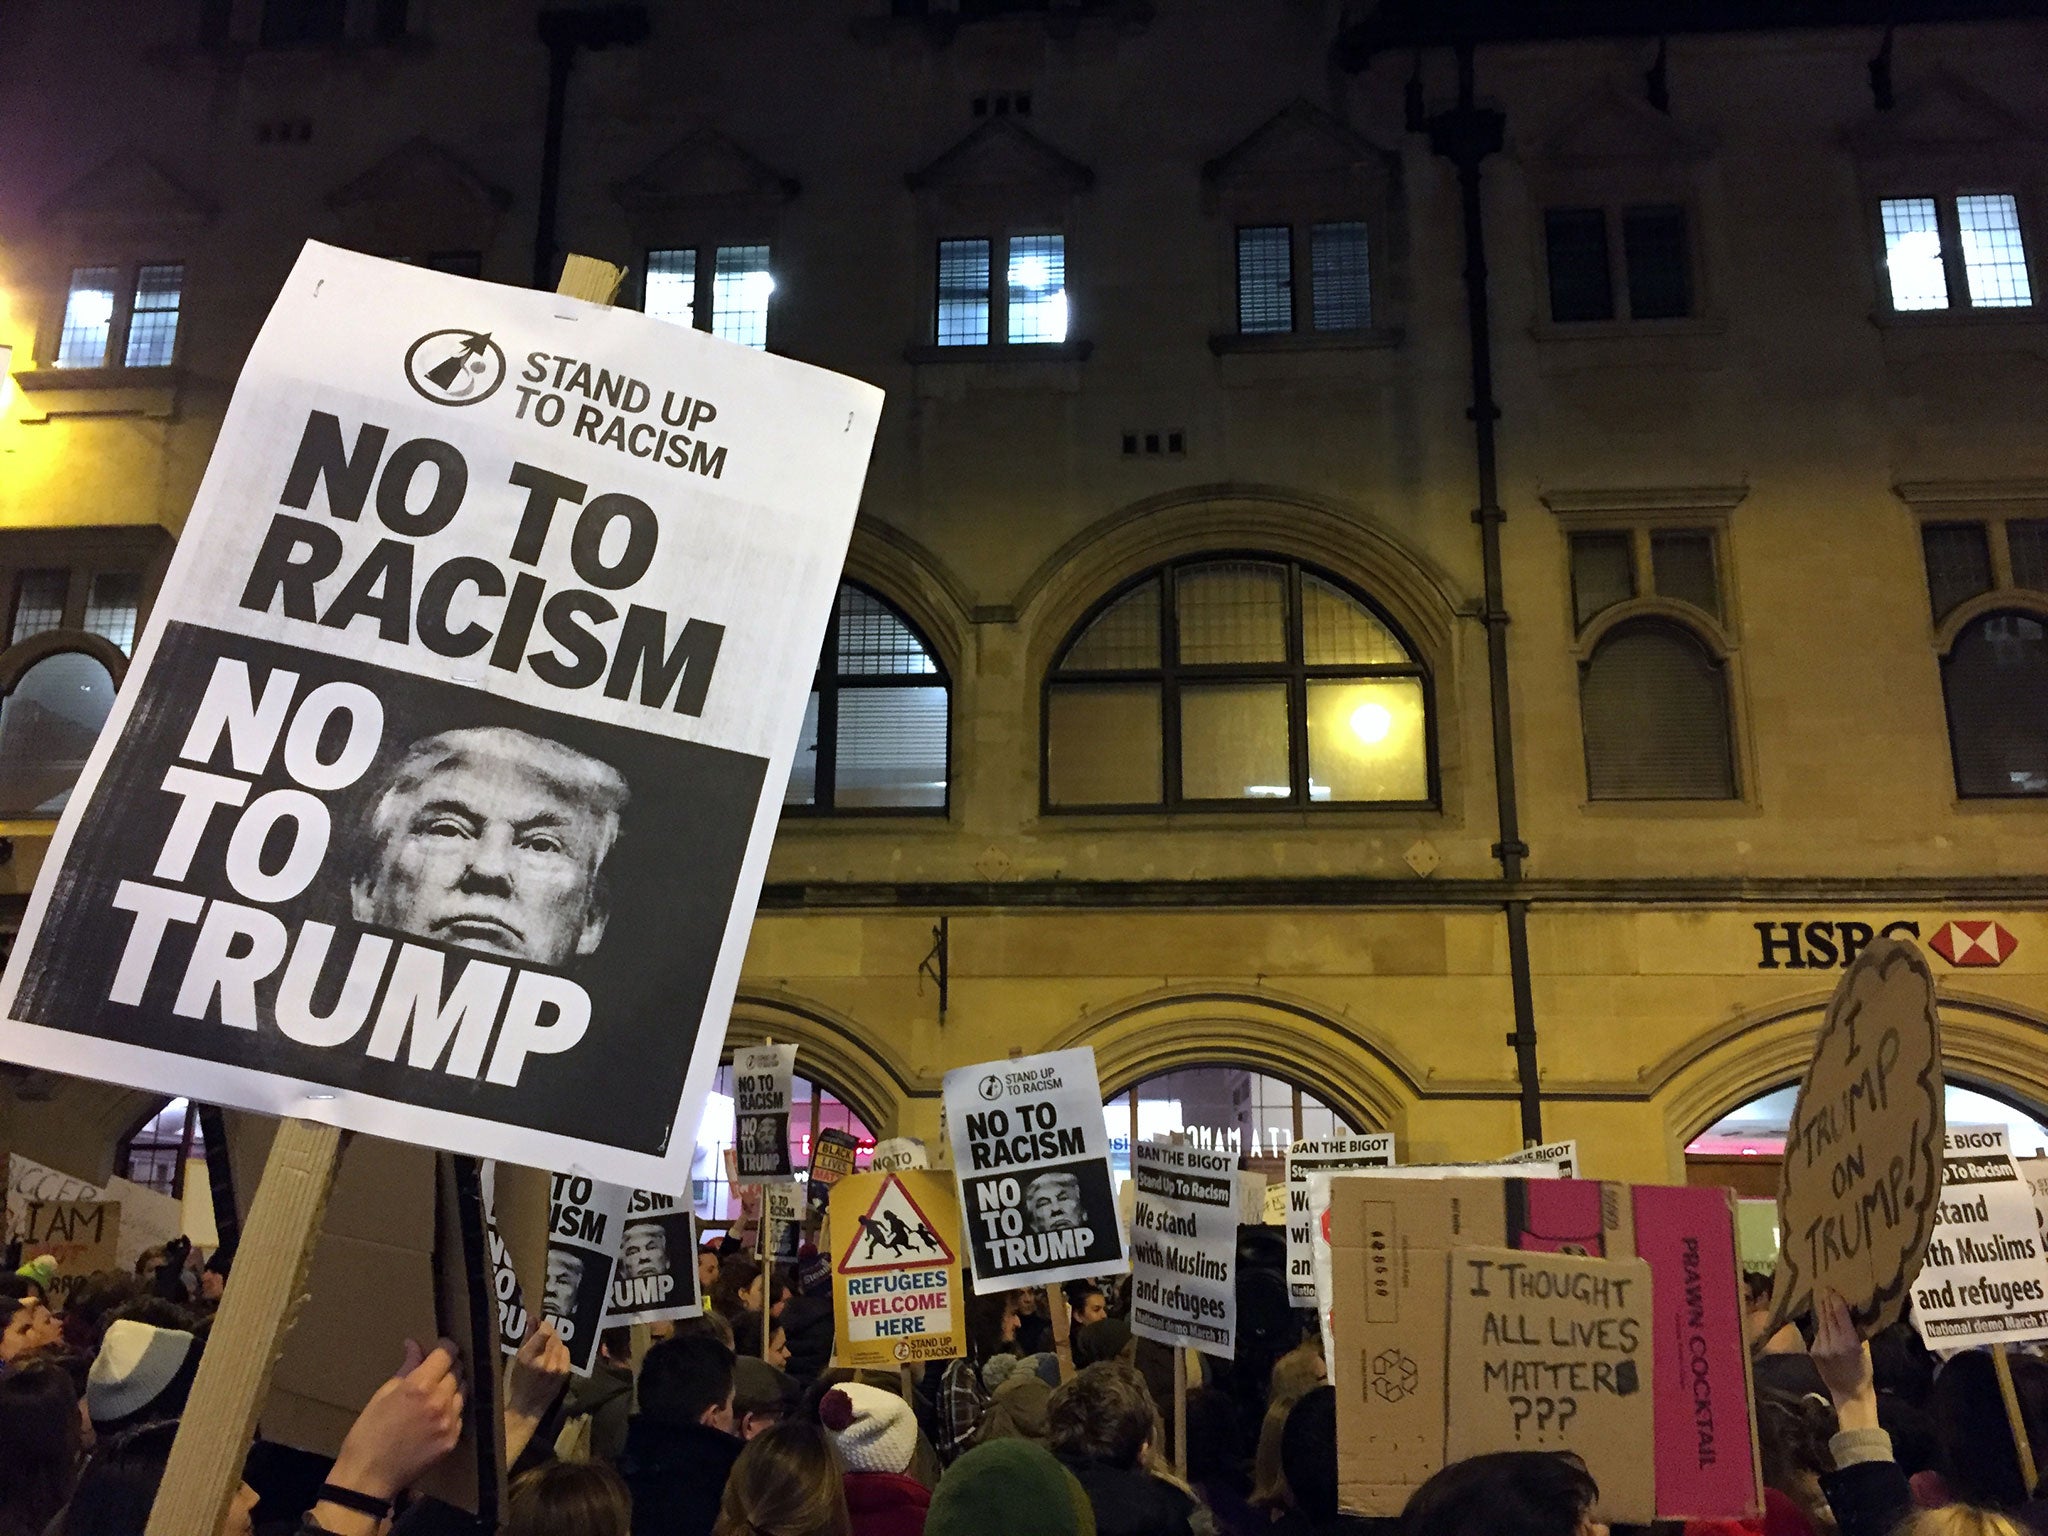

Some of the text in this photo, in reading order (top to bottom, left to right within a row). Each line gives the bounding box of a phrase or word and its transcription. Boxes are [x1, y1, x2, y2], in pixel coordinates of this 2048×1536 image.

[522, 350, 718, 431] STAND UP
[514, 390, 729, 481] TO RACISM
[281, 410, 660, 591] NO TO
[239, 513, 726, 719] RACISM
[178, 656, 386, 792] NO
[151, 766, 333, 902] TO
[107, 884, 593, 1088] TRUMP
[1845, 1000, 1861, 1065] I
[738, 1074, 773, 1092] NO TO
[1005, 1067, 1055, 1085] STAND UP
[1007, 1078, 1063, 1096] TO RACISM
[740, 1092, 783, 1110] RACISM
[1803, 1026, 1901, 1167] TRUMP
[741, 1117, 757, 1136] NO
[966, 1102, 1057, 1141] NO TO
[741, 1136, 755, 1152] TO
[822, 1143, 852, 1159] BLACK
[971, 1126, 1086, 1170] RACISM
[1292, 1138, 1389, 1154] BAN THE BIGOT
[1536, 1144, 1570, 1159] BIGOT
[1953, 1132, 2003, 1150] BIGOT
[741, 1154, 779, 1172] TRUMP
[822, 1154, 848, 1173] LIVES
[892, 1152, 912, 1165] TO
[1137, 1145, 1231, 1172] BAN THE BIGOT
[1832, 1145, 1865, 1199] ON
[1951, 1164, 1968, 1179] To
[1968, 1161, 2014, 1178] Racism
[552, 1172, 593, 1206] TO
[627, 1189, 674, 1213] ISM
[976, 1177, 1021, 1211] NO
[1162, 1177, 1175, 1196] Up
[1177, 1181, 1190, 1195] To
[1191, 1182, 1230, 1202] Racism
[25, 1202, 104, 1243] I AM
[549, 1203, 607, 1245] ISM
[769, 1205, 795, 1218] ACISM
[980, 1207, 1023, 1240] TO
[1135, 1201, 1197, 1238] We stand
[985, 1227, 1095, 1270] TRUMP
[1291, 1222, 1309, 1243] wi
[1135, 1242, 1228, 1282] with Muslims
[1291, 1259, 1311, 1275] an
[1925, 1234, 2036, 1267] ith Muslims
[849, 1271, 947, 1295] REFUGEES
[1136, 1279, 1225, 1319] and refugees
[1292, 1285, 1315, 1296] Natio
[1467, 1260, 1633, 1309] I THOUGHT
[1683, 1237, 1704, 1329] PRAWN
[1918, 1276, 2044, 1310] and refugees
[850, 1292, 947, 1317] WELCOME
[875, 1316, 925, 1337] HERE
[1483, 1312, 1541, 1346] ALL
[1550, 1316, 1640, 1354] LIVES
[1926, 1320, 1972, 1338] National
[1974, 1318, 2004, 1333] demo
[2005, 1313, 2039, 1330] March
[911, 1337, 952, 1349] STAND UP
[911, 1346, 958, 1358] TO RACISM
[1689, 1335, 1716, 1470] COCKTAIL
[1509, 1396, 1578, 1443] ???
